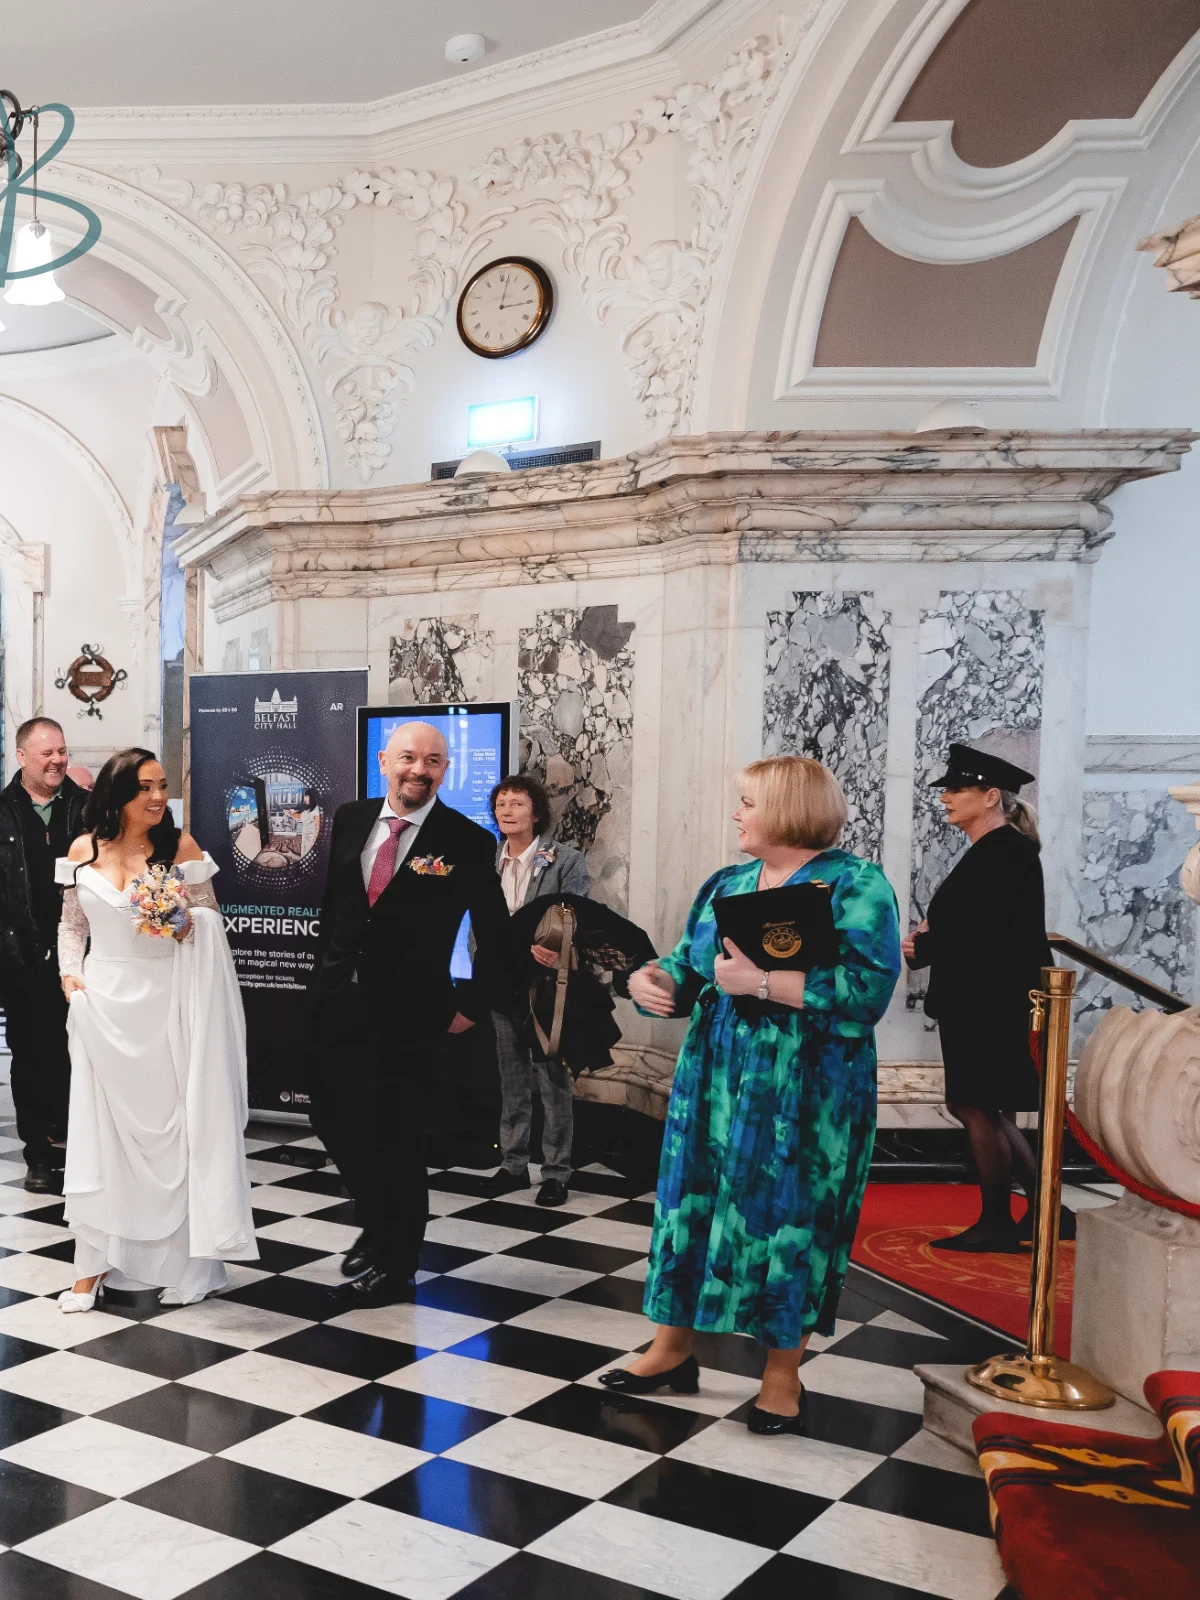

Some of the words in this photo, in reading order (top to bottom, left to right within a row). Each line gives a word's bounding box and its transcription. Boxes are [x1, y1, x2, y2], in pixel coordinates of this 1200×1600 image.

[330, 702, 343, 711] AR
[254, 713, 298, 722] BELFAST
[221, 904, 285, 916] UGMENTED
[224, 916, 320, 937] XPERIENC
[231, 948, 252, 958] plore
[254, 949, 267, 958] the
[268, 950, 296, 958] stories
[248, 959, 278, 968] magical
[298, 962, 314, 971] way
[239, 980, 307, 990] city.gov.uk/exhibition
